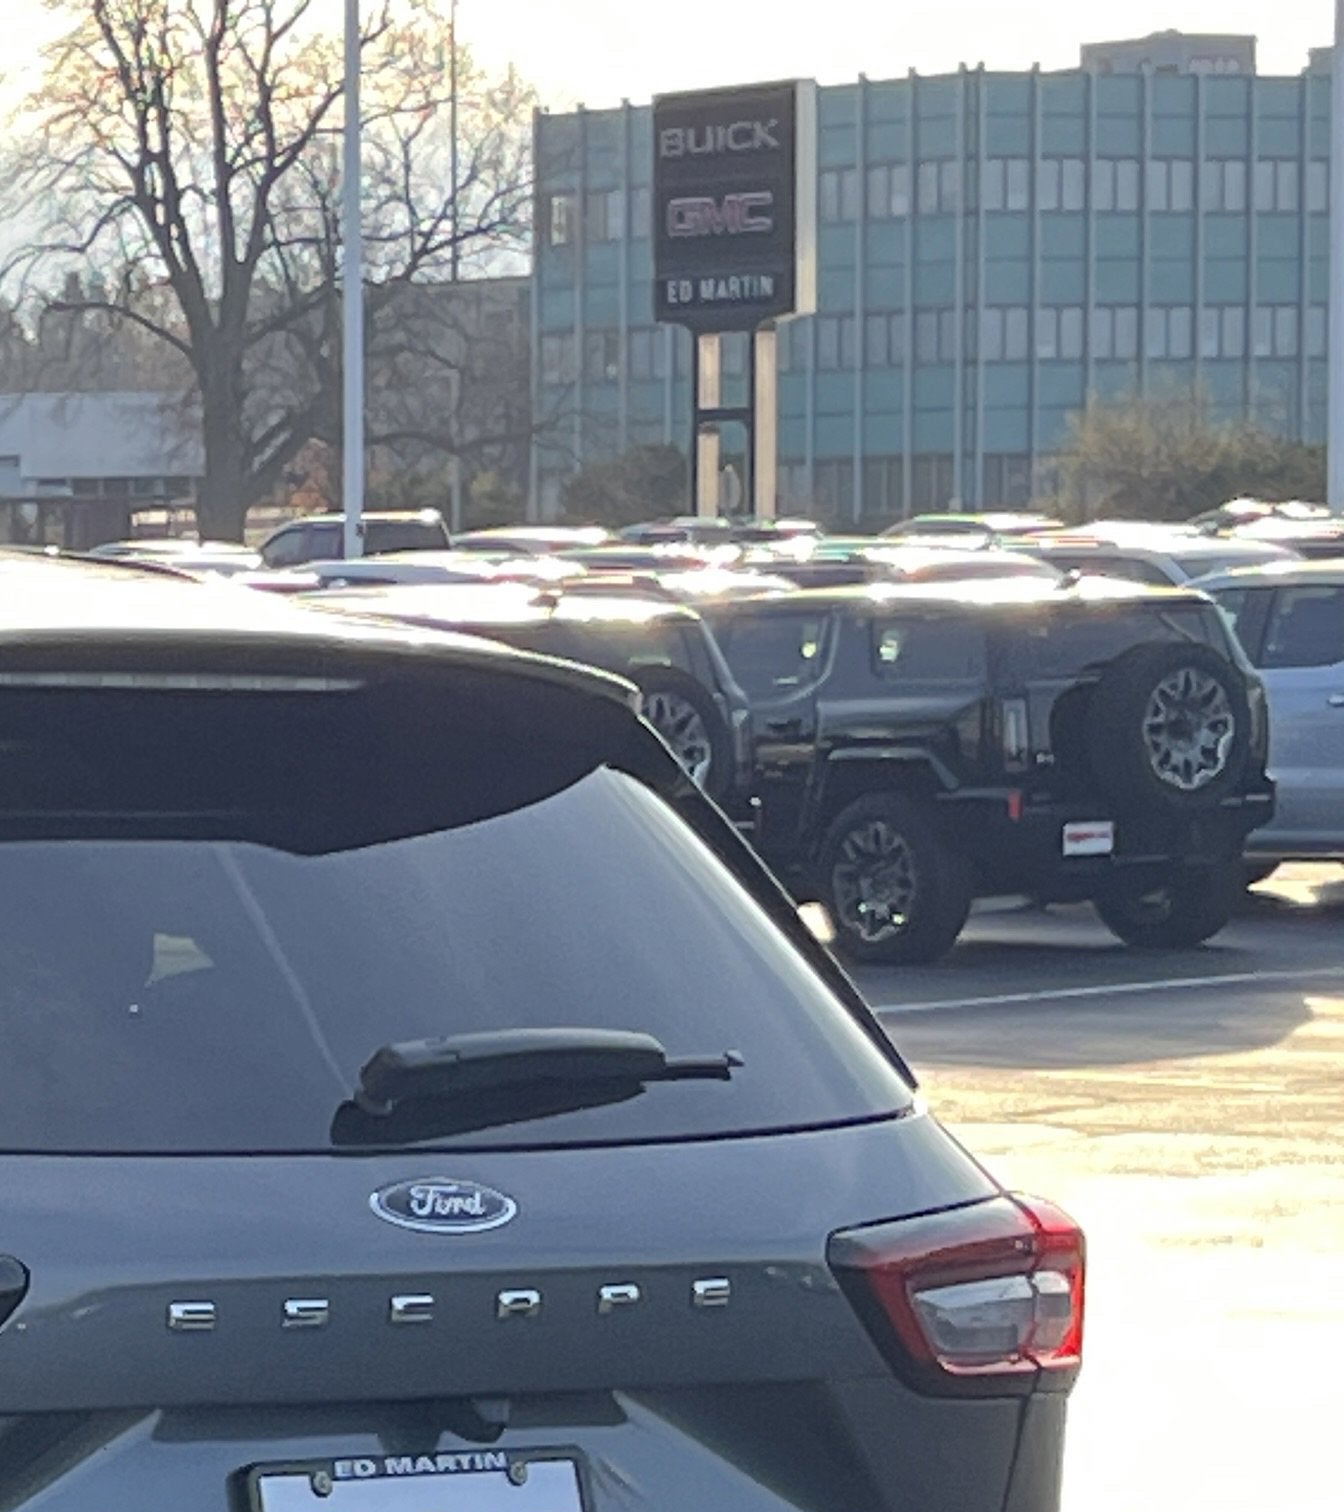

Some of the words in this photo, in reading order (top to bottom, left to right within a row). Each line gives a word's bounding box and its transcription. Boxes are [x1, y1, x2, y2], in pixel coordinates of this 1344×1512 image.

[661, 119, 780, 159] BUICK
[667, 190, 774, 239] GMC
[667, 279, 693, 304] ED
[699, 275, 775, 302] MARTIN
[410, 1184, 487, 1217] Ford
[168, 1277, 731, 1330] ESCAPE
[334, 1456, 377, 1479] ED
[384, 1451, 508, 1476] MARTIN
